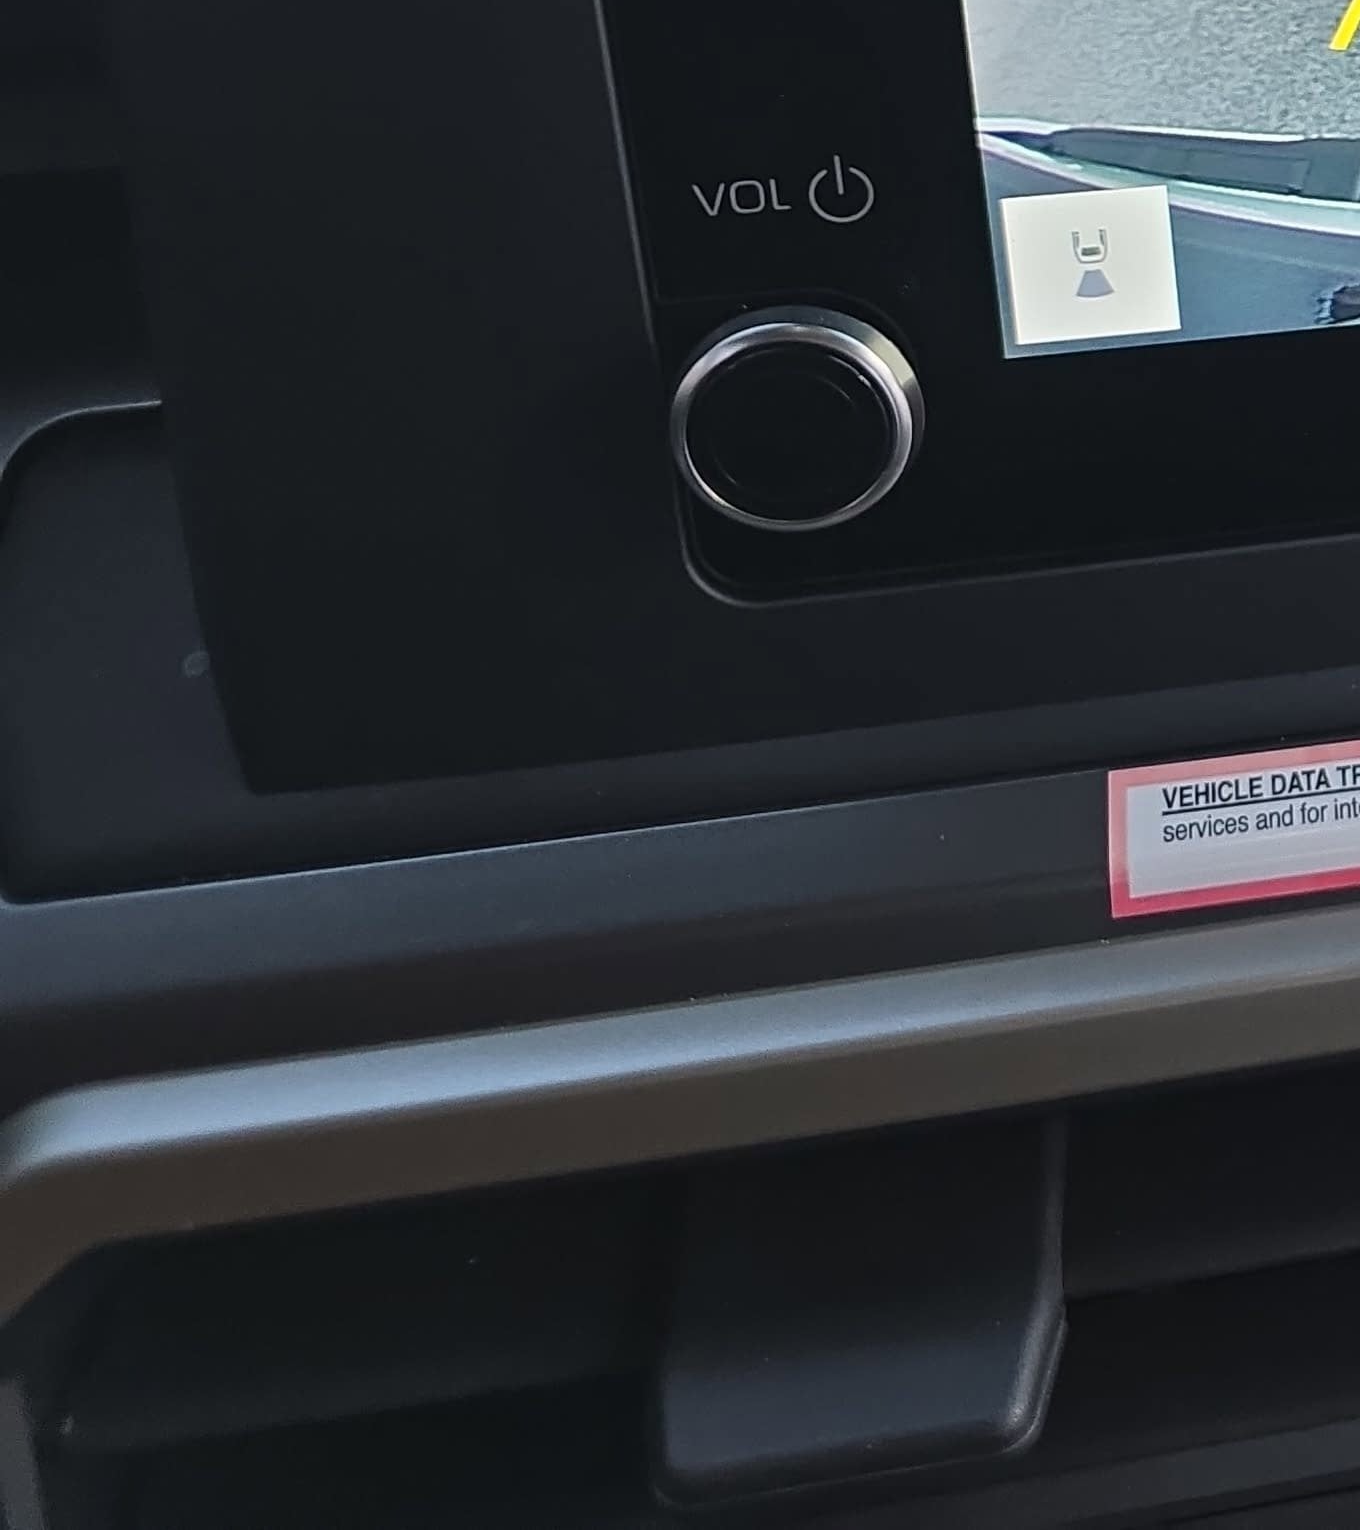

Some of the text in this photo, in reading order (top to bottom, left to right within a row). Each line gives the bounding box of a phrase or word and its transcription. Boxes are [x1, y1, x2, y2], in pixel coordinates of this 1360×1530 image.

[691, 178, 792, 217] VOL
[1162, 776, 1263, 809] VEHICLE
[1271, 767, 1331, 795] DATA
[1163, 814, 1249, 843] services
[1255, 804, 1294, 830] and
[1299, 802, 1329, 824] for
